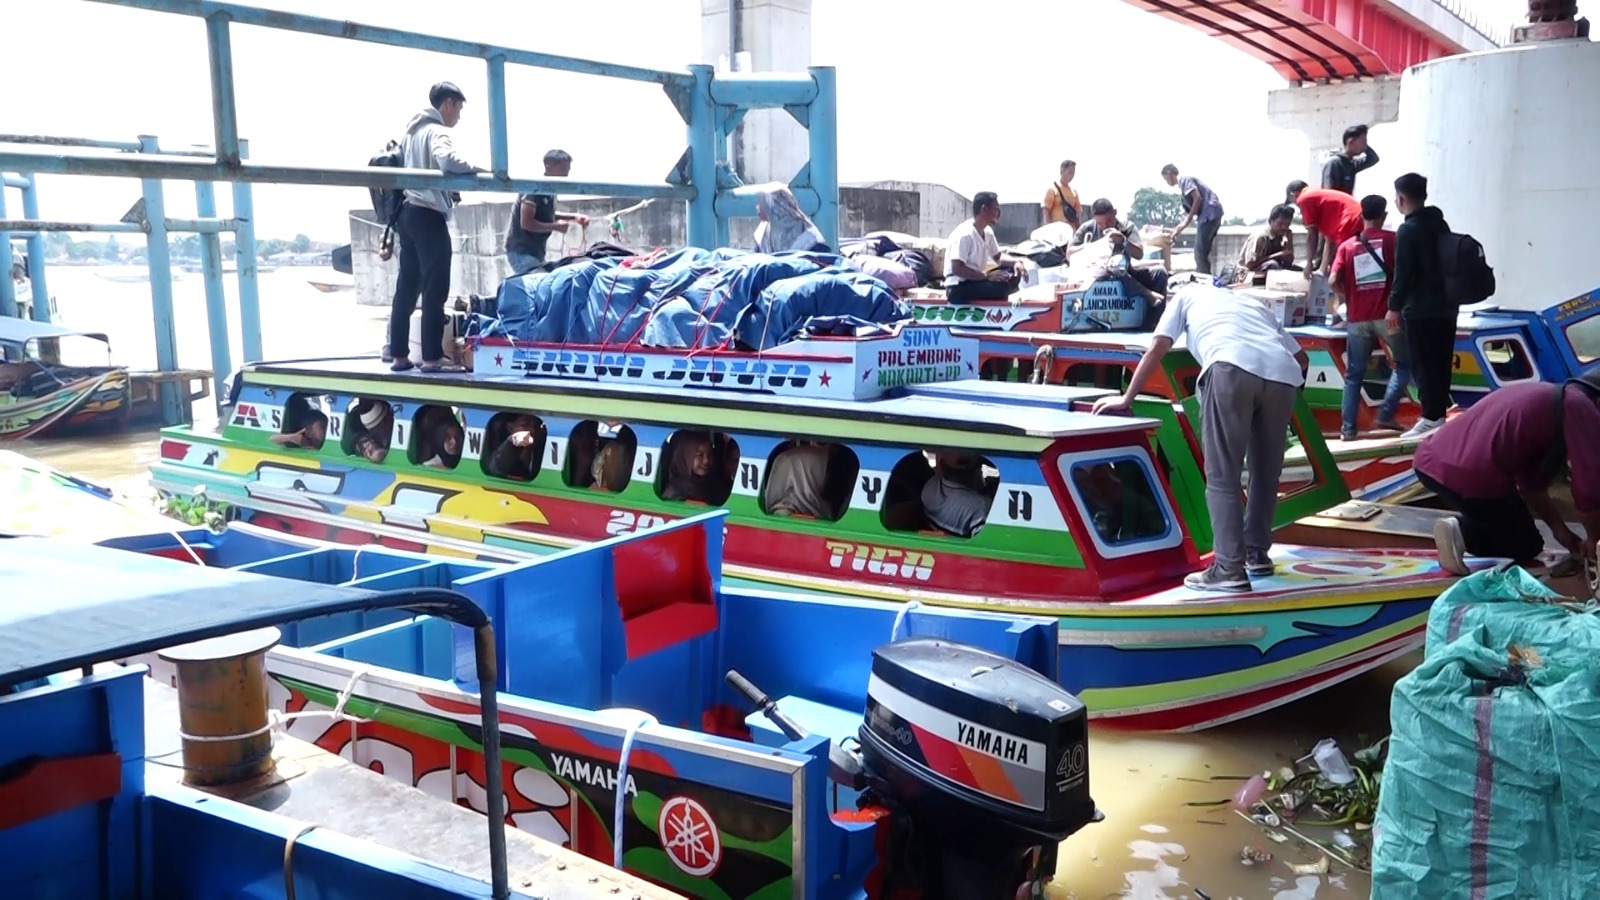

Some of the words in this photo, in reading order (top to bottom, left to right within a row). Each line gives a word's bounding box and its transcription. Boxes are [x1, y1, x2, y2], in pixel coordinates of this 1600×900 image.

[903, 329, 941, 347] SONY
[878, 348, 961, 368] PALEMBANG
[957, 722, 1028, 764] YAMAHA
[551, 752, 638, 797] YAMAHA
[1056, 744, 1085, 778] 40
